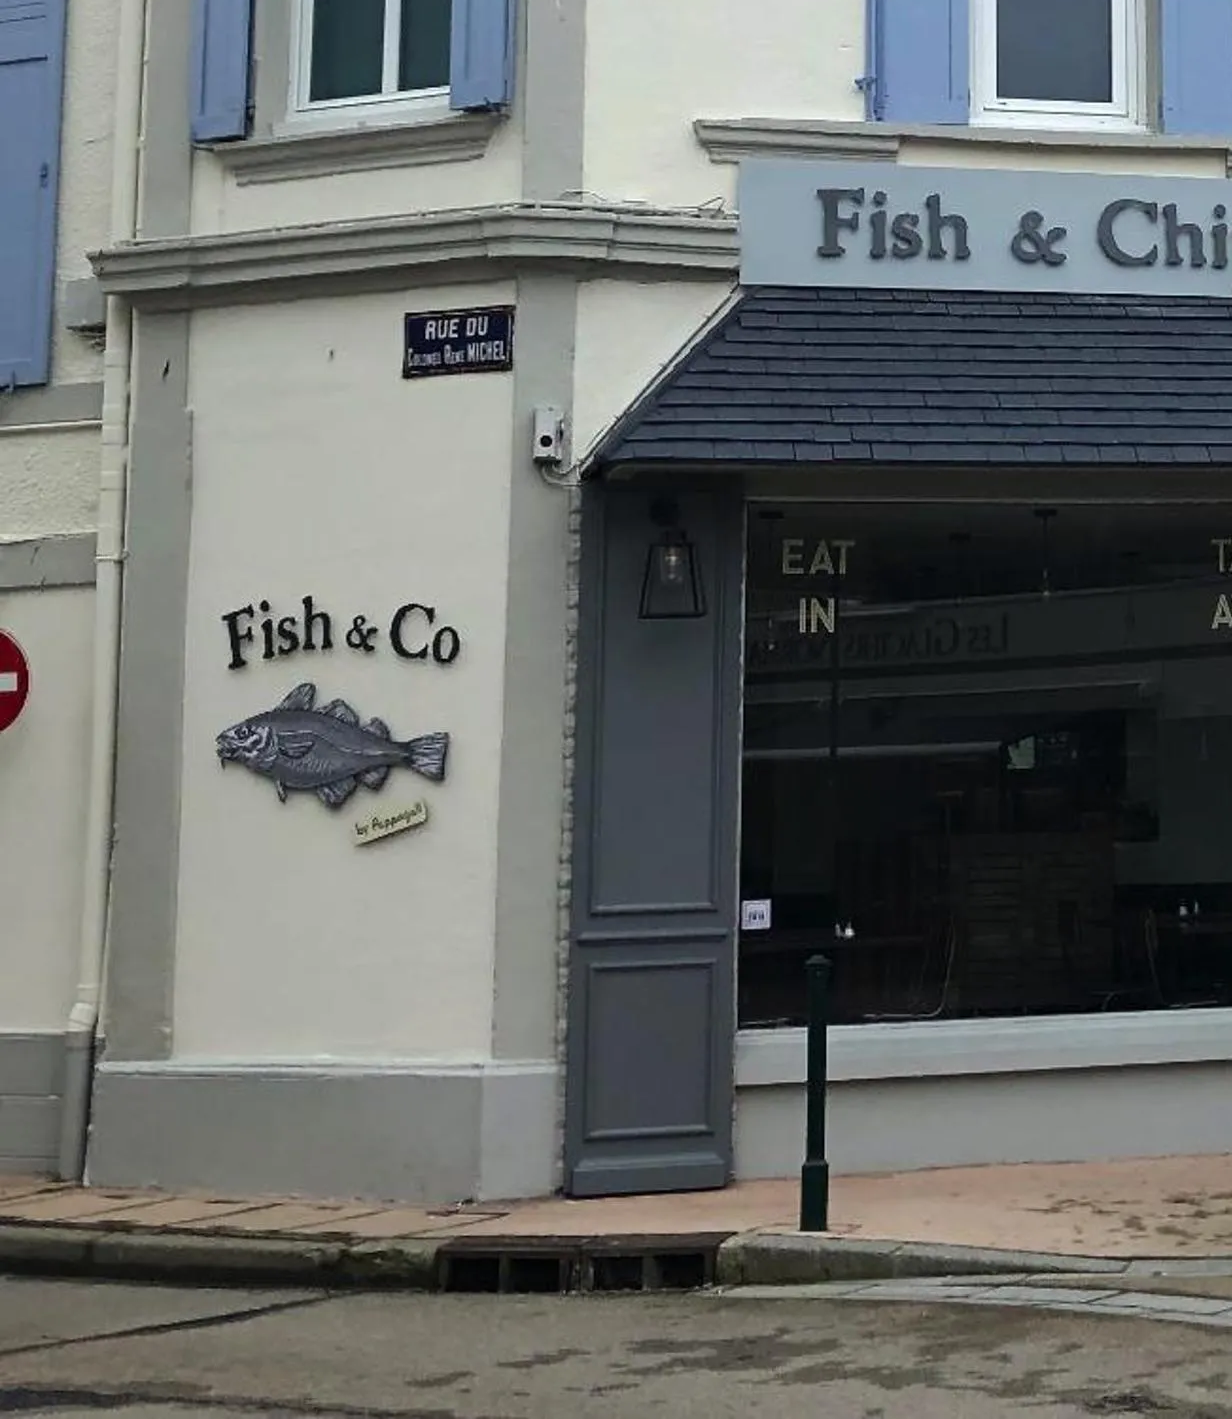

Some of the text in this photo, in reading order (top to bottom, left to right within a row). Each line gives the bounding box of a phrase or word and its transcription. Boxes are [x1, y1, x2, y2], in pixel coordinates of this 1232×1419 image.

[816, 187, 970, 260] Fish
[1010, 210, 1068, 267] &
[425, 316, 489, 340] RUE DU
[782, 538, 856, 575] EAT
[221, 595, 461, 670] Fish & Co
[799, 597, 835, 633] IN
